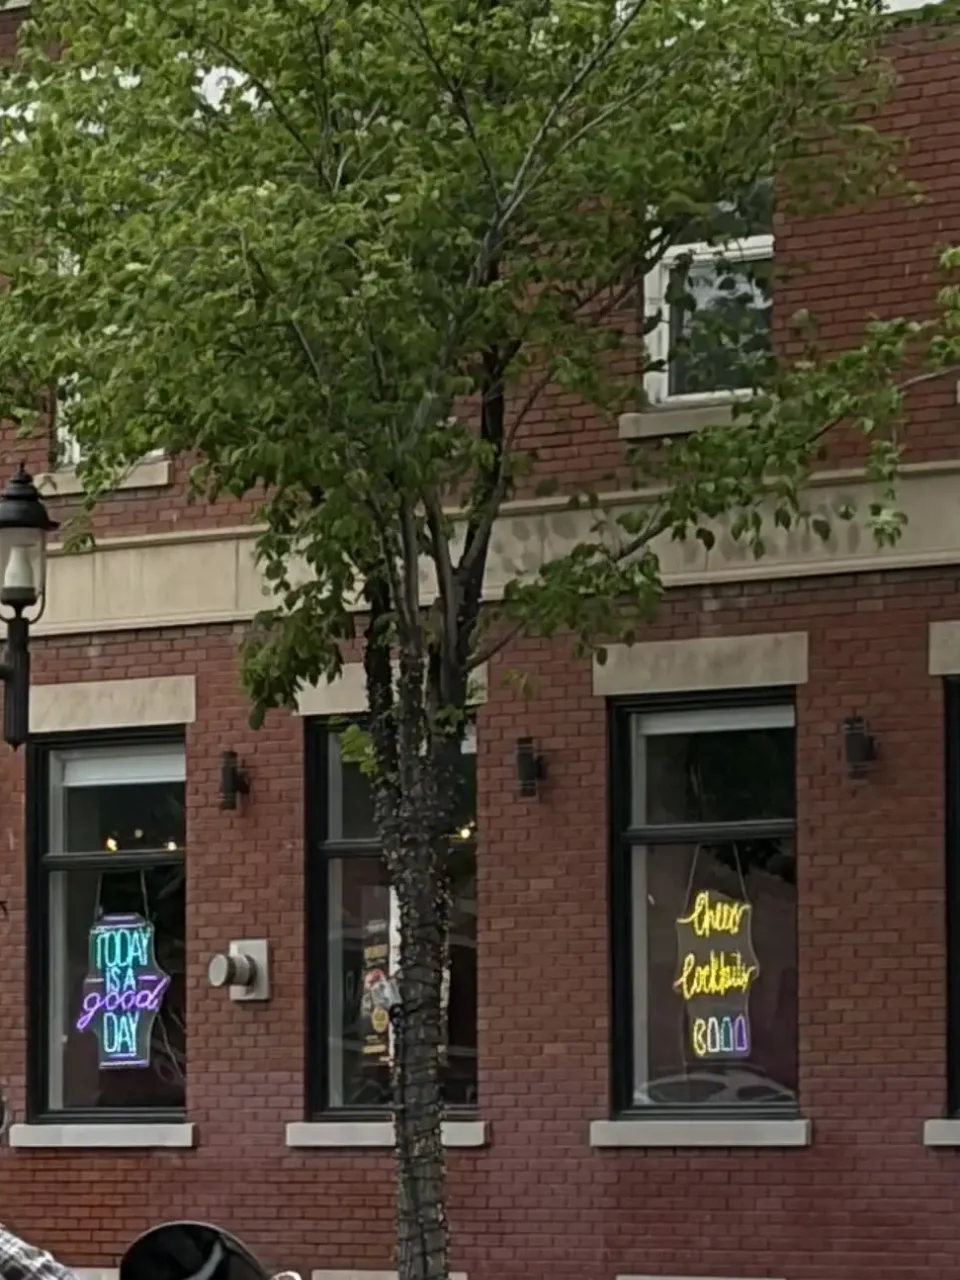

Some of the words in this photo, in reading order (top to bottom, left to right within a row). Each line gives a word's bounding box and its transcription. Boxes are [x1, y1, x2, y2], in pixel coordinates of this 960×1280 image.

[96, 928, 151, 969] TODAY
[105, 967, 121, 993] IS
[123, 967, 137, 992] A
[76, 976, 171, 1031] good
[103, 1011, 140, 1054] DAY
